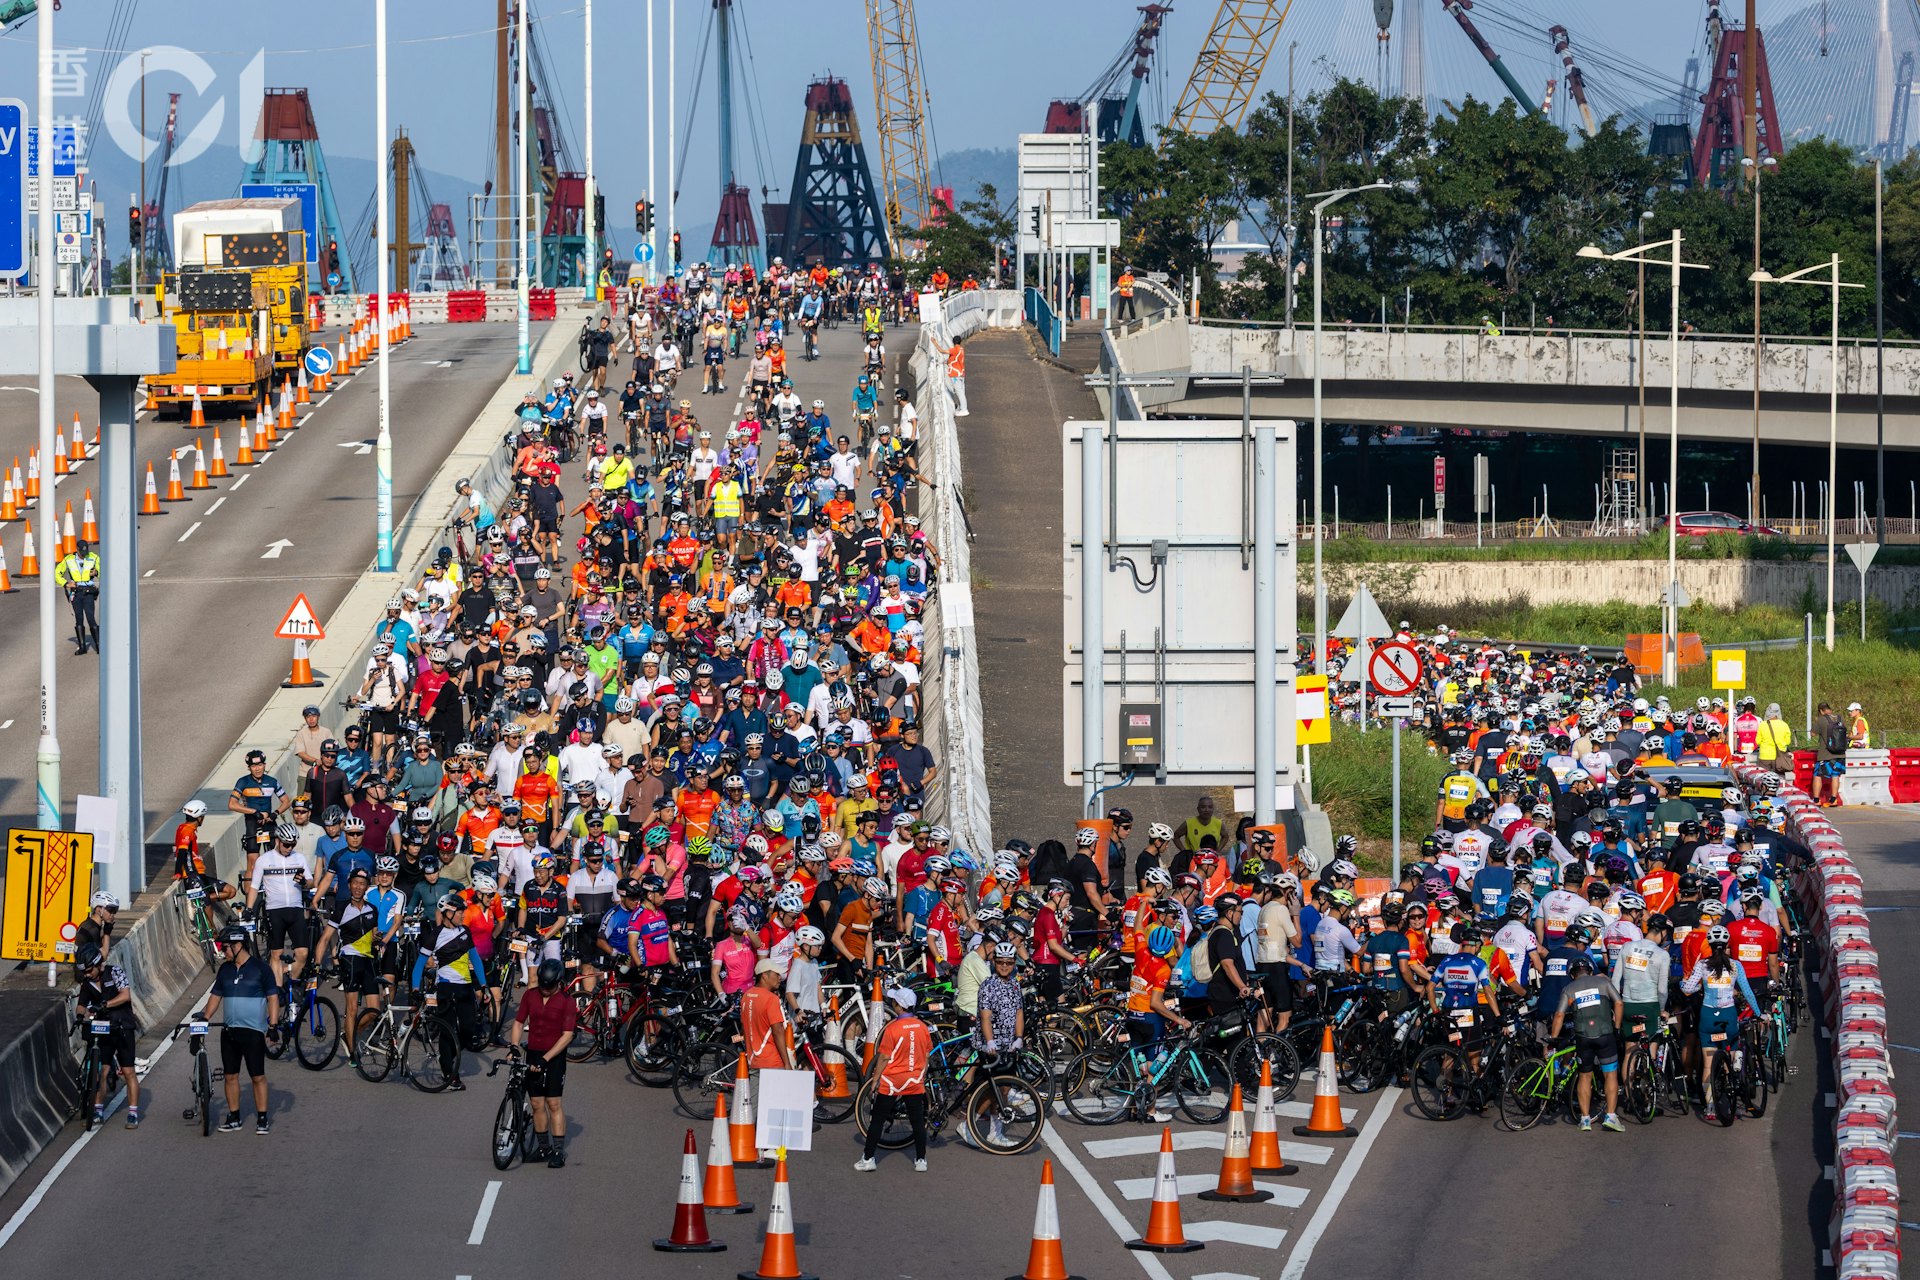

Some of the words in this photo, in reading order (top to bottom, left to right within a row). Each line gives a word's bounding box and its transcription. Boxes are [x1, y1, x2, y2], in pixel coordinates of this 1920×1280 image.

[16, 948, 44, 958] 佐敦道
[1580, 995, 1596, 1003] 7228
[1151, 1047, 1181, 1087] Bianchi
